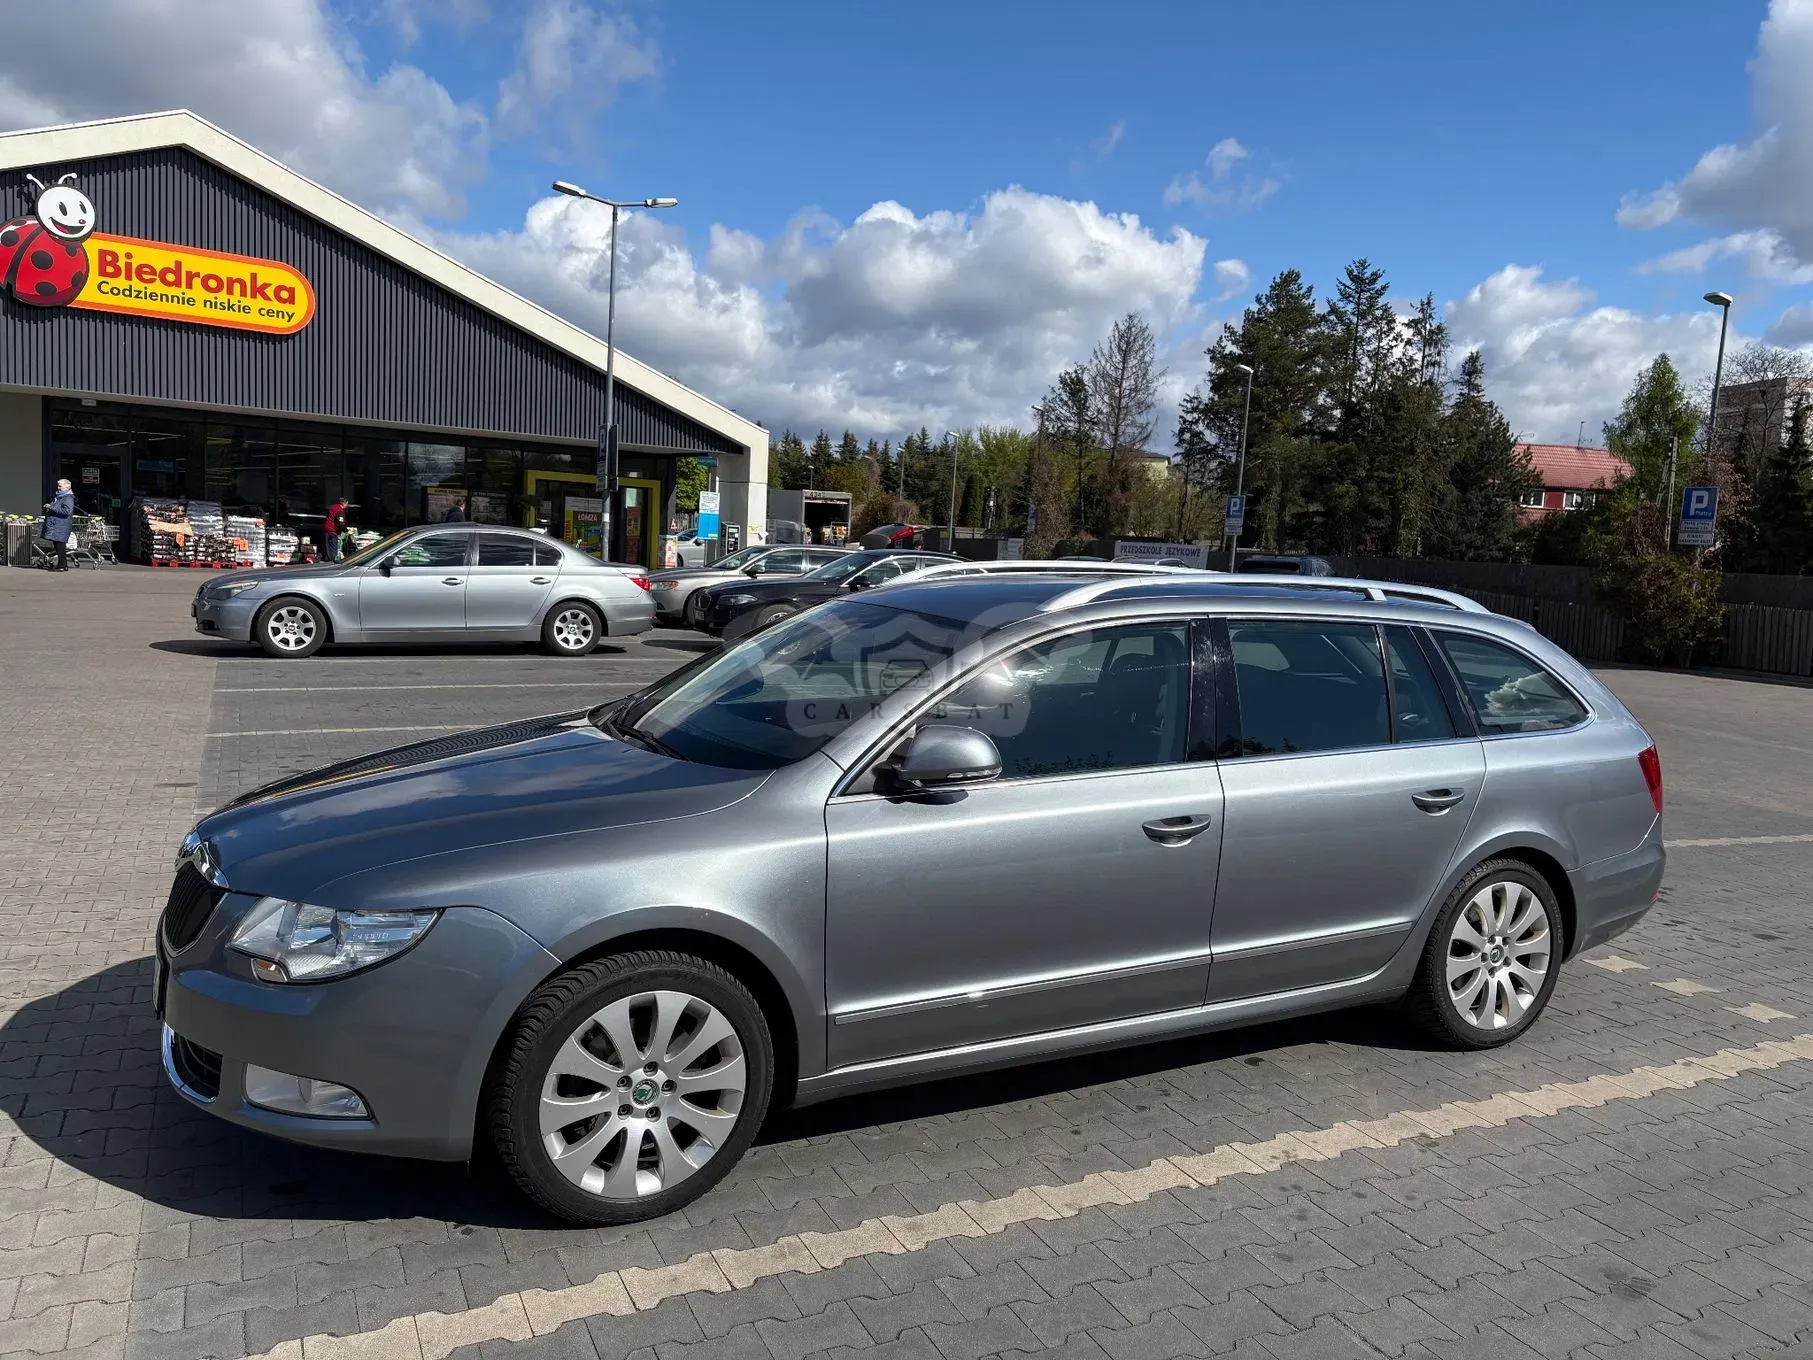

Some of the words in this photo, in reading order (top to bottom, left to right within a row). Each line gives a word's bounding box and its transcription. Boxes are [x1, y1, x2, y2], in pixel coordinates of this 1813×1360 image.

[97, 248, 296, 305] Biedronka
[97, 280, 196, 307] Codziennie
[203, 296, 252, 315] niskie
[258, 307, 296, 323] ceny
[1230, 498, 1240, 516] P
[1689, 490, 1709, 516] P
[1120, 545, 1163, 556] PRZEDSZKOLE
[1165, 547, 1202, 558] JĘZYKOWE
